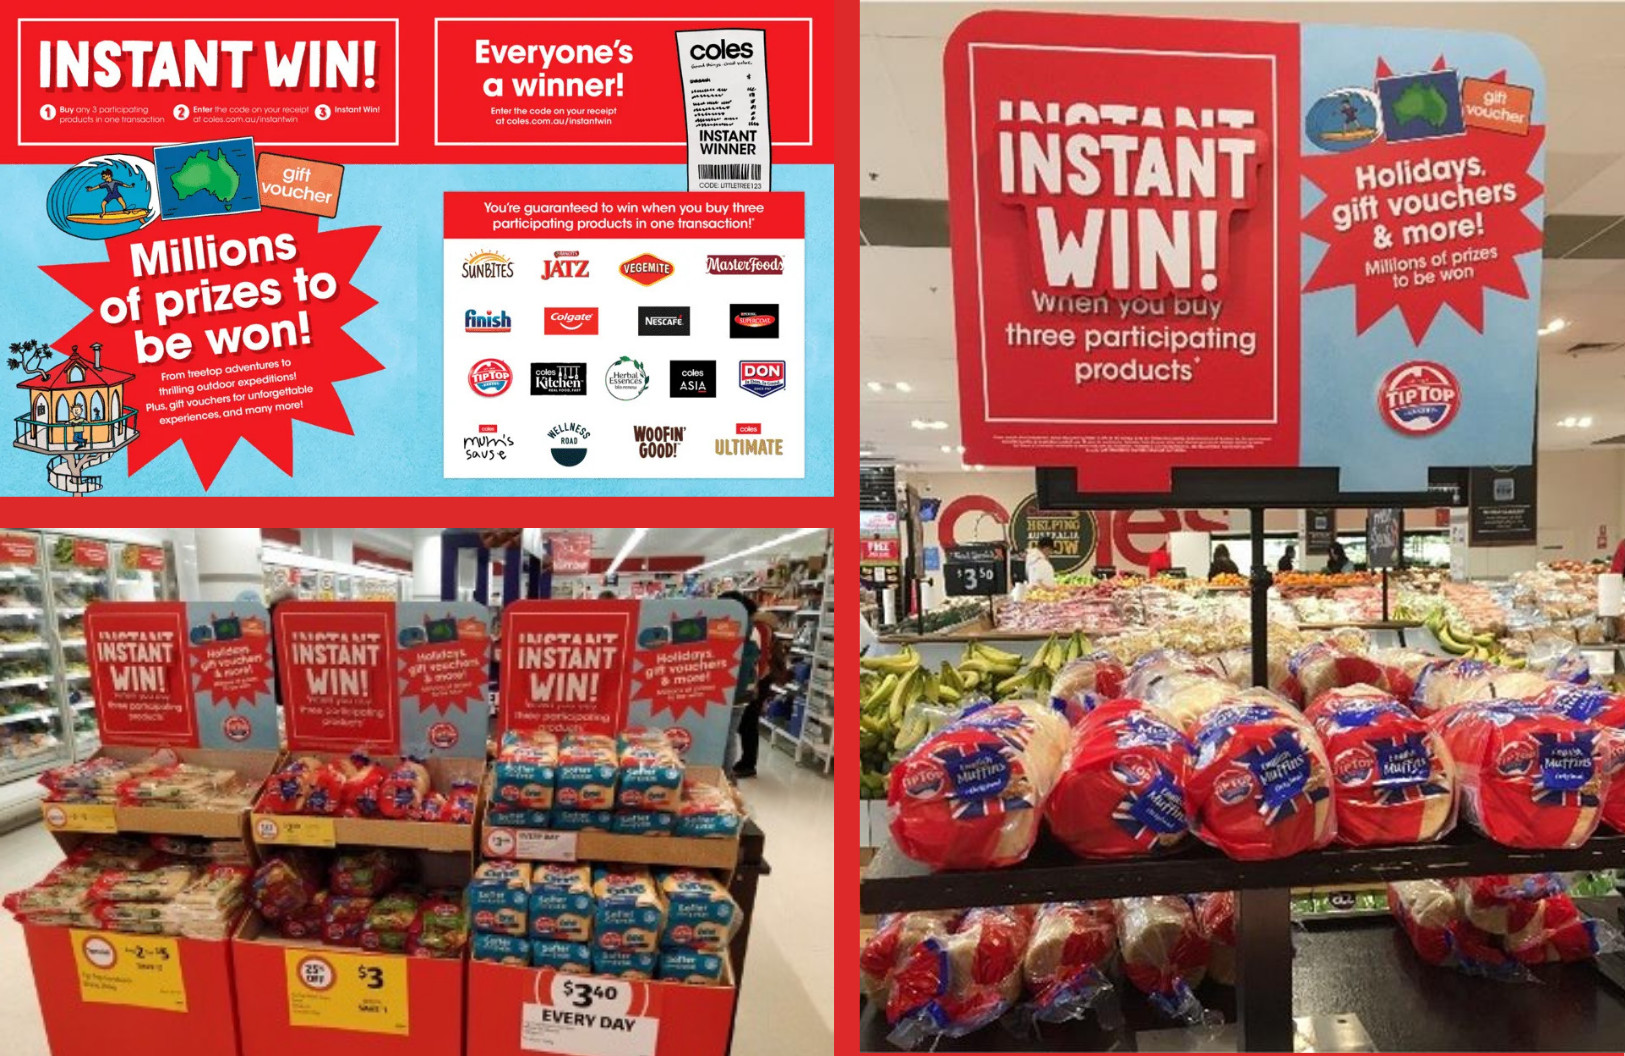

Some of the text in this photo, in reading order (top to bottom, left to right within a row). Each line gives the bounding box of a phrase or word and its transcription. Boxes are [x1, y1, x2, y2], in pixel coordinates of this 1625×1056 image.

[475, 39, 634, 69] Everyone’s
[690, 39, 753, 60] coles
[40, 39, 377, 89] INSTANT WIN!
[482, 72, 625, 97] a winner!
[1483, 90, 1508, 106] gift
[60, 105, 149, 117] Buy any 3 participating
[193, 106, 213, 114] Enter
[215, 106, 228, 114] the
[230, 106, 250, 114] code
[264, 108, 281, 117] your
[283, 105, 310, 117] receipt
[335, 106, 380, 114] Instant Win!
[491, 107, 511, 115] Enter
[513, 107, 527, 115] the
[528, 107, 551, 115] code
[566, 109, 585, 118] your
[586, 106, 617, 118] receipt
[1466, 104, 1525, 124] voucher
[60, 116, 94, 126] products
[95, 116, 103, 124] in
[122, 116, 165, 124] transaction
[203, 116, 299, 125] coles.com.au/instantwin
[496, 117, 612, 126] at coles.com.au/instantwin
[700, 130, 757, 142] INSTANT
[700, 143, 756, 155] WINNER
[282, 166, 312, 184] gift
[1000, 131, 1255, 199] INSTANT
[261, 181, 334, 205] voucher
[524, 202, 598, 217] guaranteed
[601, 203, 614, 214] to
[616, 202, 639, 214] win
[642, 202, 675, 214] when
[678, 205, 703, 217] you
[706, 202, 729, 217] buy
[732, 202, 765, 214] three
[1332, 182, 1517, 232] gift vouchers
[493, 217, 574, 231] participating
[577, 217, 633, 231] products
[635, 217, 647, 229] in
[650, 219, 675, 229] one
[1373, 212, 1484, 250] & more!
[130, 232, 298, 278] Millions
[1036, 206, 1217, 291] WIN!
[541, 259, 590, 280] JATZ
[623, 262, 670, 276] VEGEMITE
[706, 254, 785, 274] MasterFoods
[1365, 247, 1498, 276] Millions of prizes
[1392, 266, 1475, 289] to be won
[100, 266, 337, 326] of prizes to
[1032, 290, 1222, 320] When you buy
[465, 309, 511, 329] finish
[550, 311, 593, 323] Colgate
[134, 311, 312, 364] be won!
[1006, 323, 1256, 355] three participating
[161, 358, 292, 381] From treetop adventures to
[613, 371, 638, 379] Herbal
[682, 369, 704, 377] coles
[744, 365, 780, 378] DON
[159, 371, 297, 397] thrilling outdoor expeditions!
[535, 376, 581, 390] Kitchen
[609, 378, 642, 386] Essences
[680, 380, 707, 391] ASIA
[145, 384, 314, 413] Plus, gift vouchers for unforgettable
[159, 400, 303, 426] experiences, and many more!
[547, 422, 591, 440] WELLNESS
[739, 425, 757, 433] coles
[463, 434, 515, 449] mum's
[560, 437, 577, 445] ROAD
[639, 441, 678, 458] GOOD!
[715, 439, 784, 456] ULTIMATE
[1027, 520, 1080, 531] HELPING
[97, 643, 174, 663] INSTANT
[292, 644, 380, 666] INSTANT
[518, 647, 618, 670] INSTANT
[109, 666, 166, 693] WIN!
[306, 668, 368, 697] WIN!
[530, 673, 598, 702] WIN!
[956, 763, 1006, 783] Muffins
[1262, 755, 1304, 784] Muffins
[1544, 757, 1592, 770] Muffins
[542, 1009, 636, 1032] EVERY DAY
